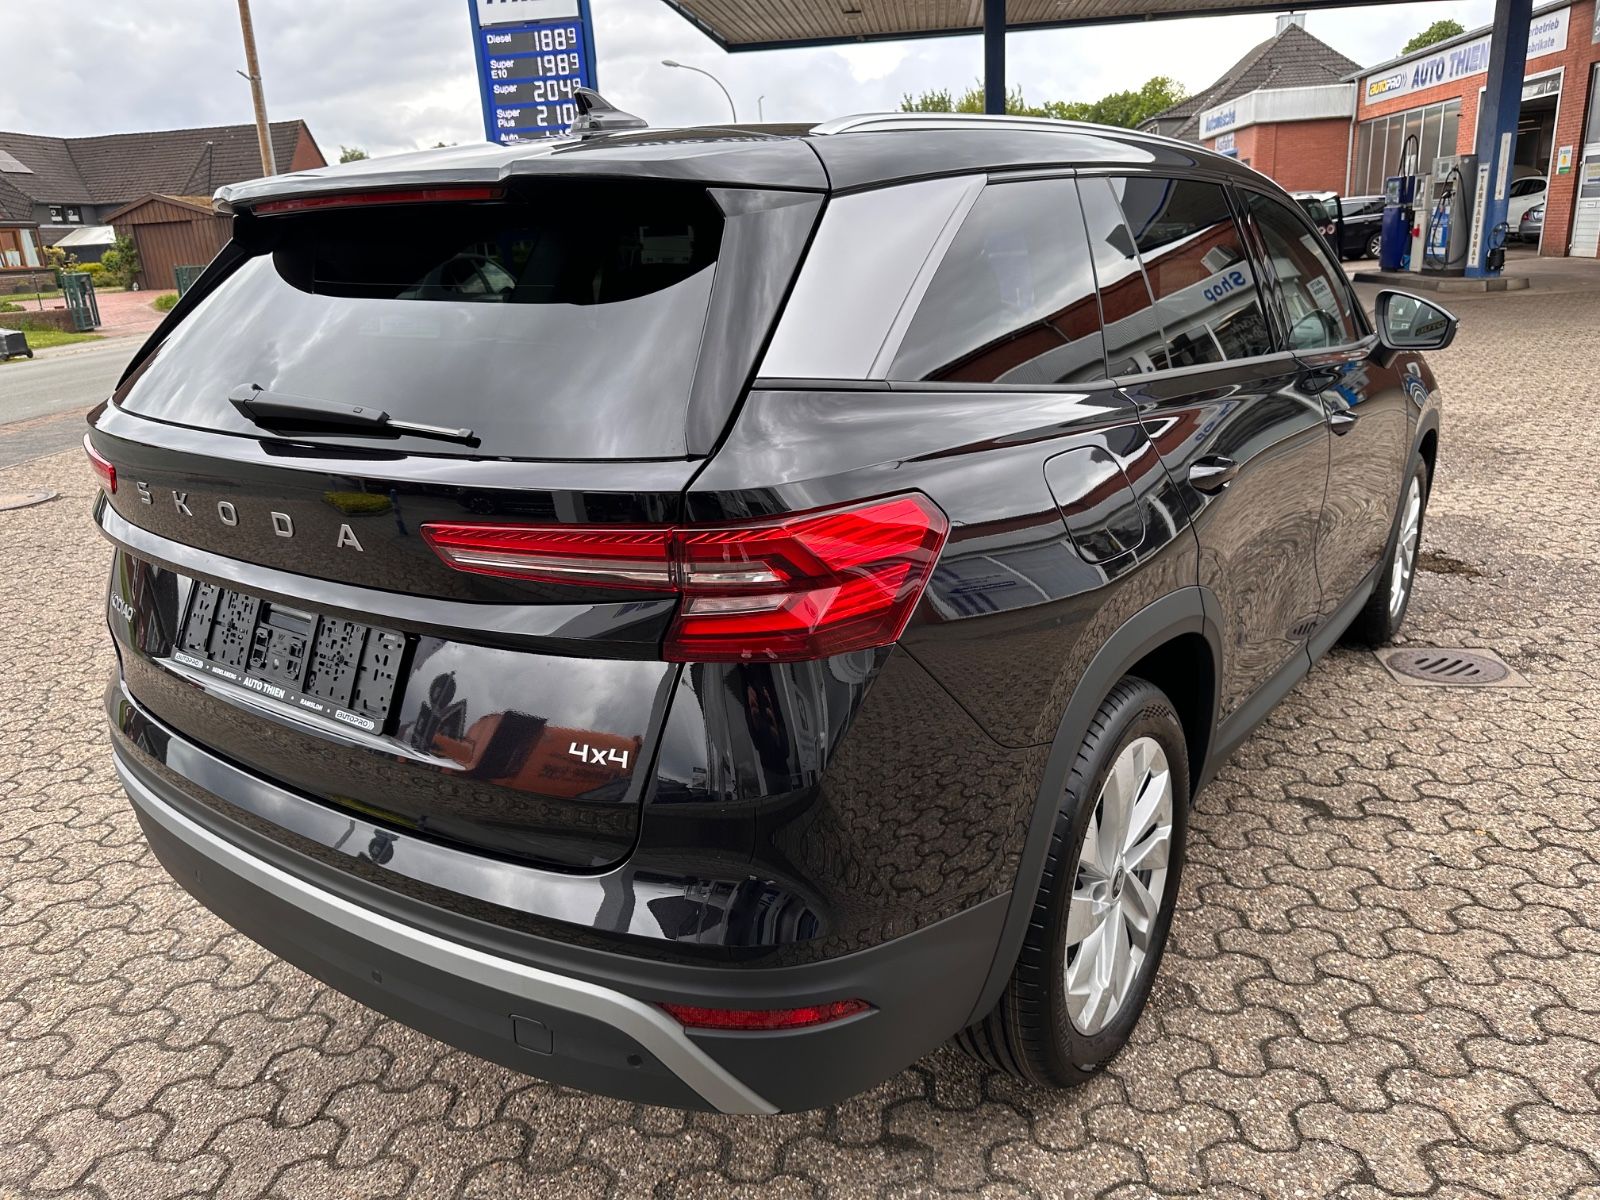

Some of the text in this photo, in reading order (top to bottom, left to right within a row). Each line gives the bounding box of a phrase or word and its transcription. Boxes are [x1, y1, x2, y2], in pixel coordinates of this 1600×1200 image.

[486, 33, 512, 44] Diesel
[490, 60, 514, 71] Super
[1410, 56, 1445, 89] AUTO
[1448, 41, 1490, 78] THIEN
[491, 69, 508, 79] E10
[493, 84, 517, 95] Super
[496, 109, 520, 120] Super
[497, 118, 515, 128] Plus
[136, 481, 364, 552] SKODA
[243, 676, 263, 690] AUTO
[263, 683, 286, 699] THIEN
[568, 742, 629, 769] 4x4
